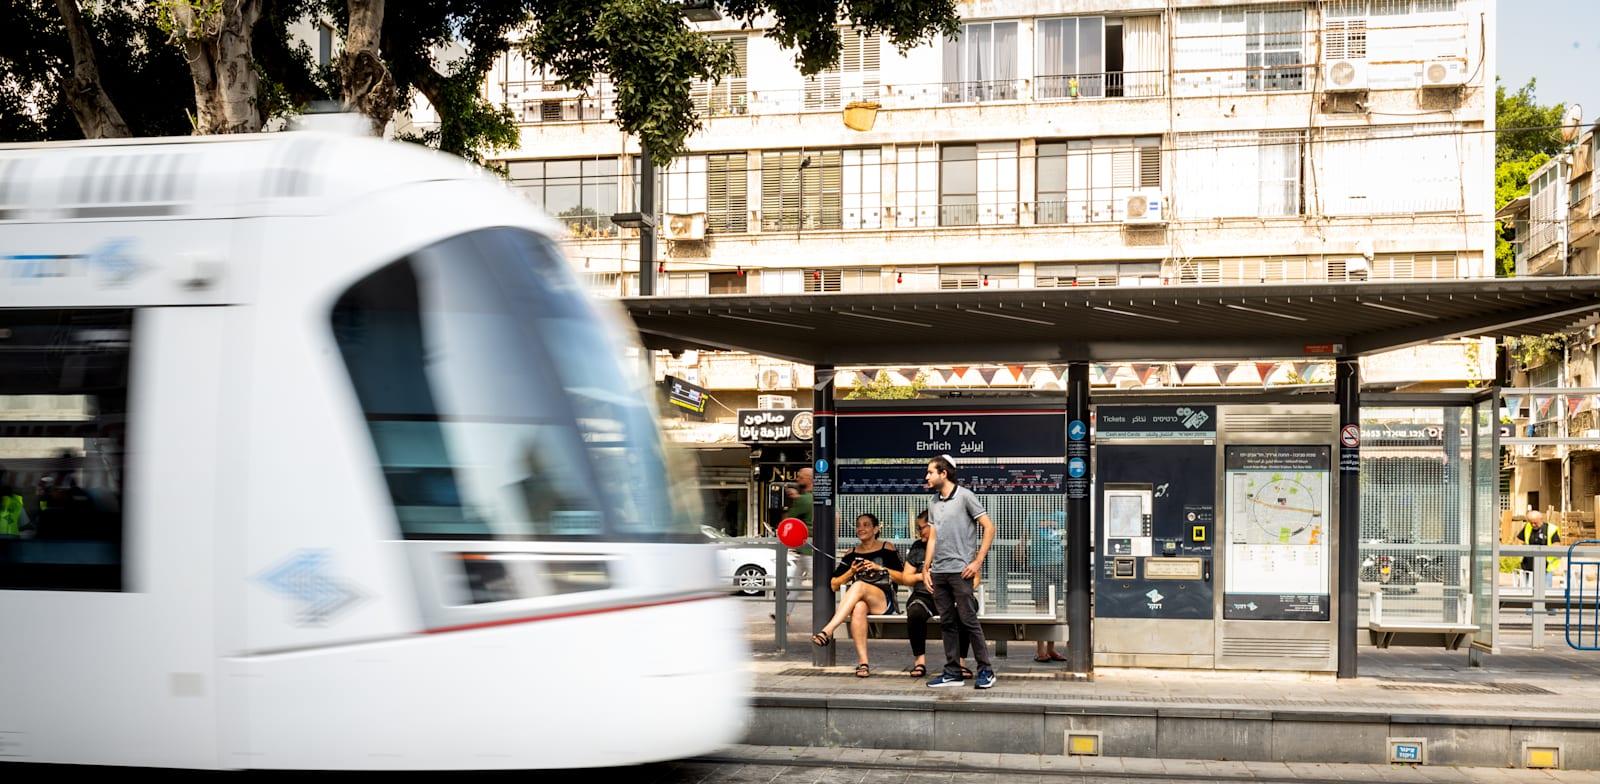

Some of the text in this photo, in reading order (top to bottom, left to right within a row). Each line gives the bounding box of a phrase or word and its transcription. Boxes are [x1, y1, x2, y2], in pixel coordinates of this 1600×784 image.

[744, 413, 785, 425] صالون
[1102, 415, 1126, 423] Tickets
[740, 426, 791, 441] النزهة يافا
[922, 418, 977, 440] ארליך
[816, 426, 826, 448] 1
[916, 441, 951, 451] Ehrlich
